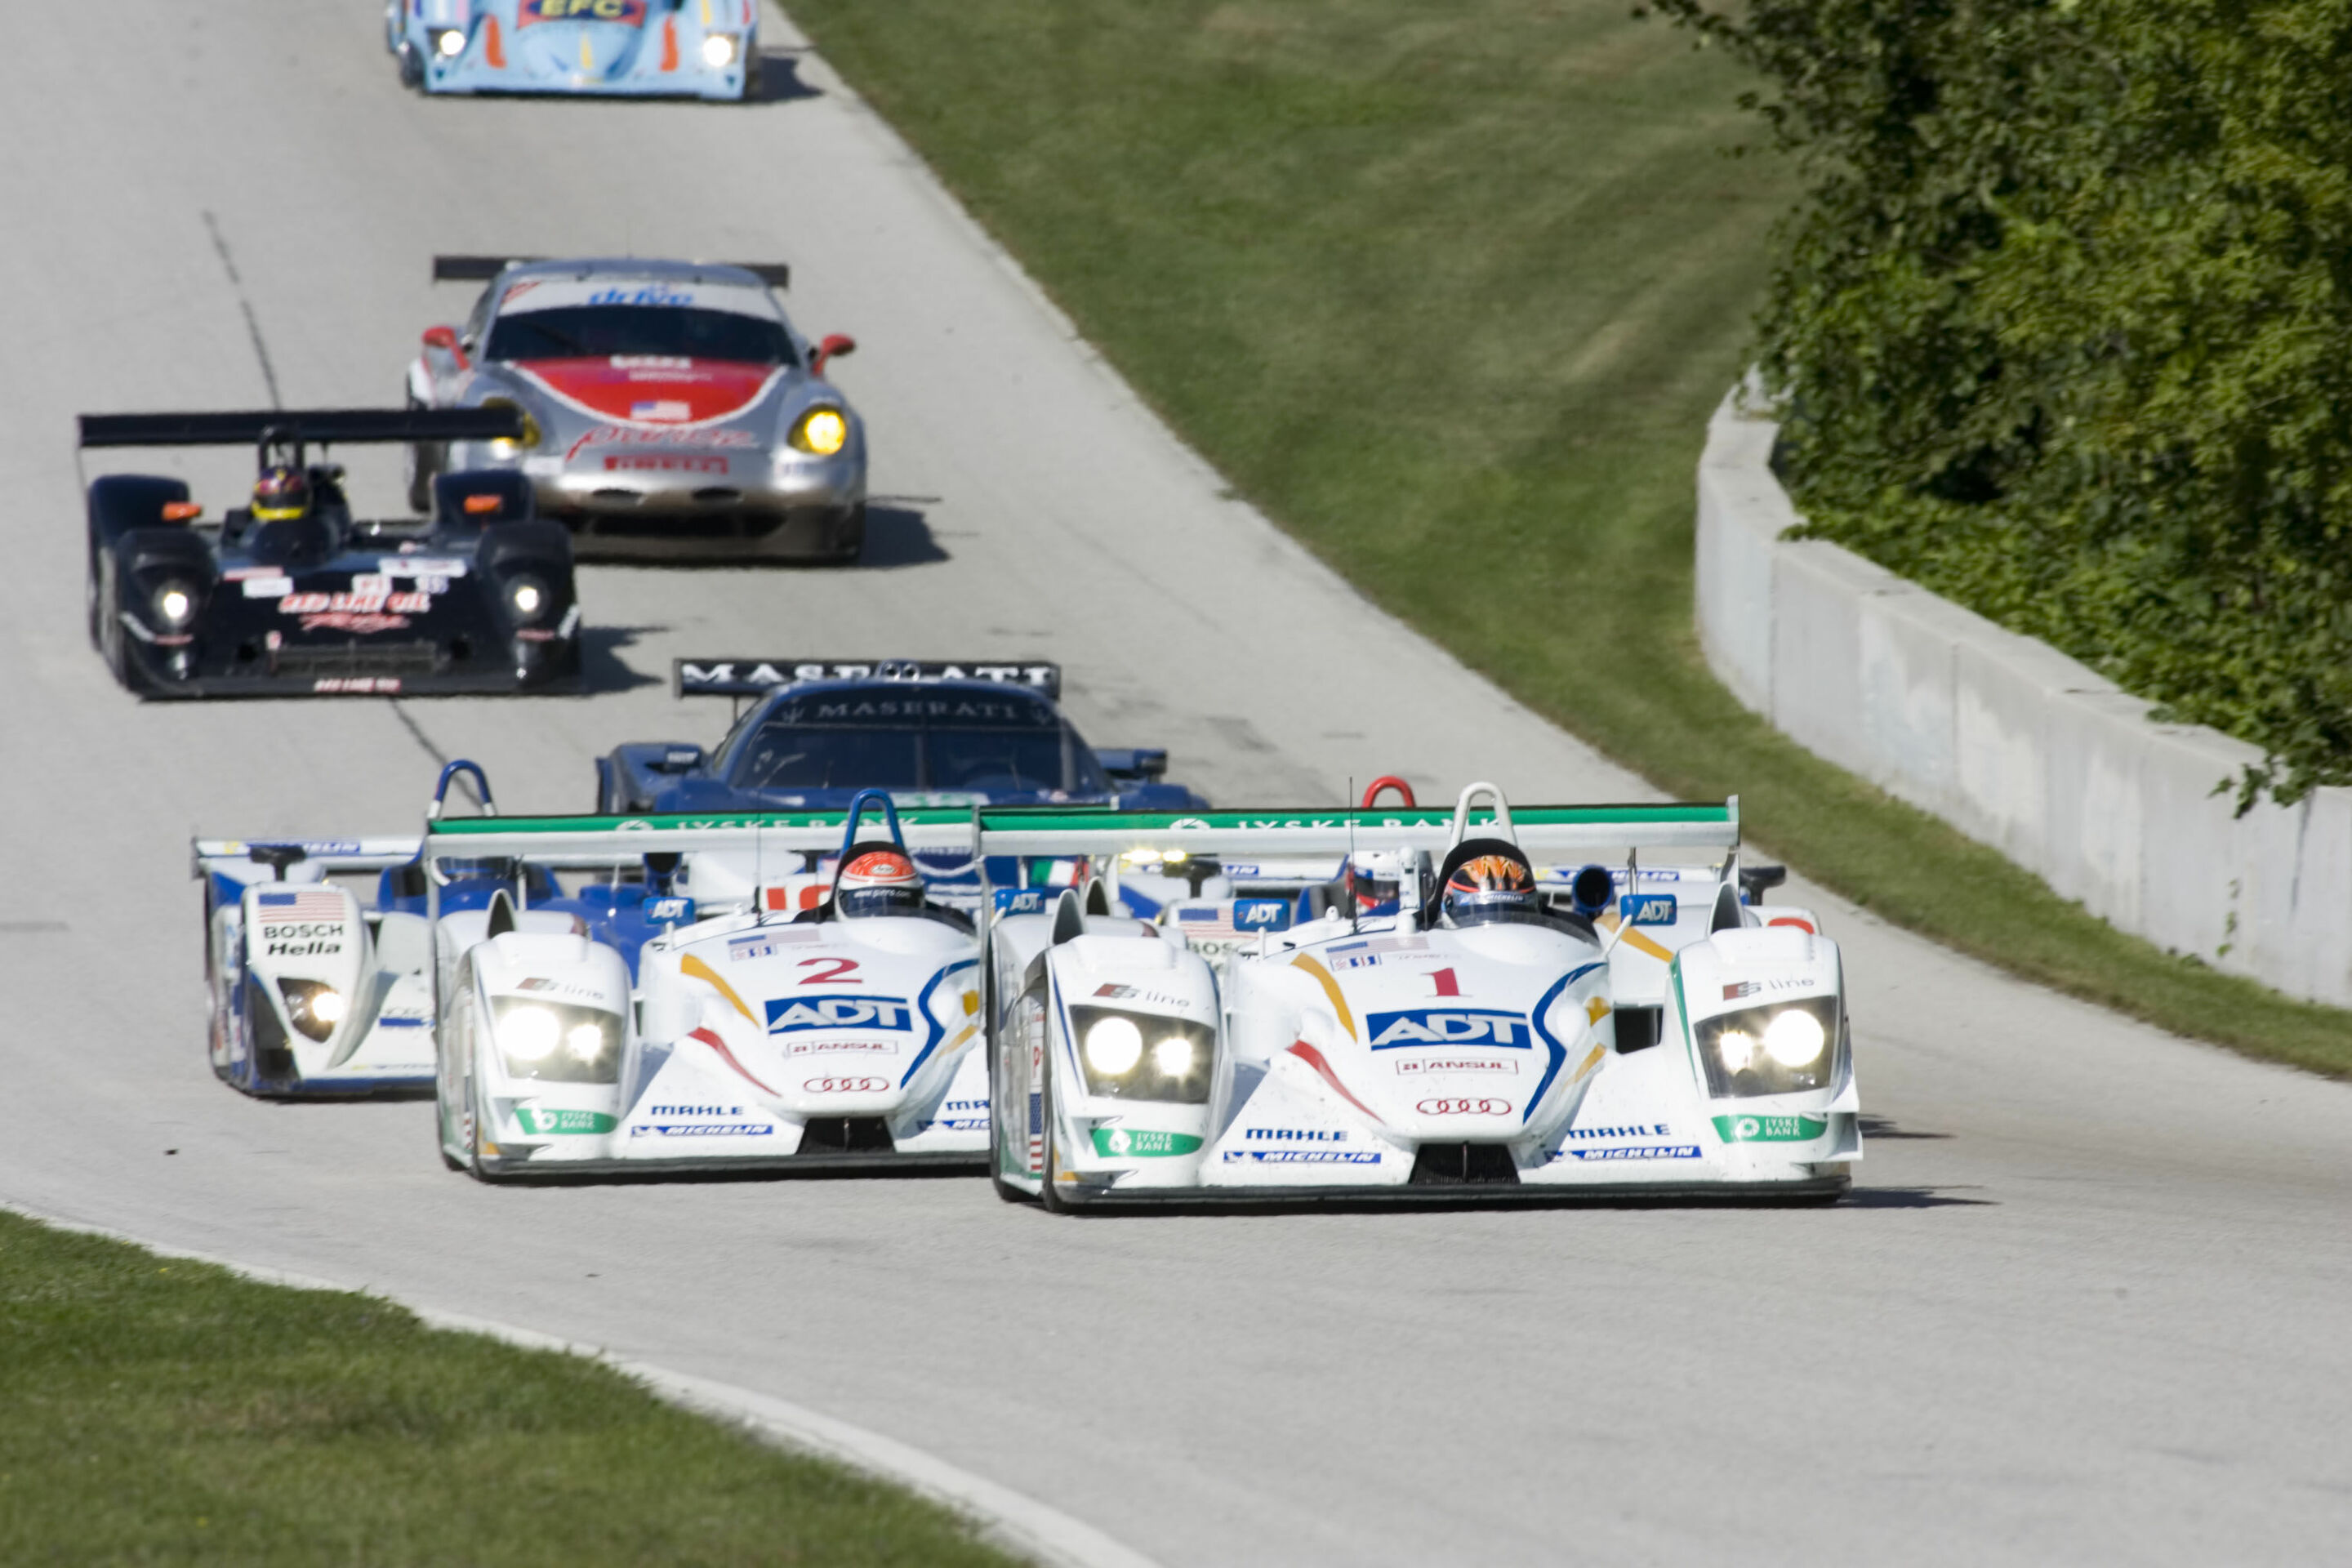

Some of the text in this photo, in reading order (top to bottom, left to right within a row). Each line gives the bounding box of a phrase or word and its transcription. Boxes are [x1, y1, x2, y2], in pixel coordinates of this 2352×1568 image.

[681, 662, 1051, 686] MASEATI
[817, 699, 1017, 717] MASERATI
[653, 899, 688, 918] ADT
[1009, 893, 1040, 911] ADT
[1245, 903, 1283, 924] ADT
[1636, 900, 1673, 923] ADT
[264, 923, 344, 938] BOSCH
[267, 941, 342, 956] Hella
[1189, 942, 1236, 956] BOS
[796, 957, 863, 986] 2
[1419, 967, 1473, 998] 1
[1768, 978, 1815, 990] line
[1145, 990, 1191, 1007] line
[768, 998, 908, 1031] ADT
[1370, 1013, 1529, 1046] ADT
[817, 1042, 890, 1051] ANSUL
[1428, 1061, 1509, 1070] ANSUL
[651, 1105, 745, 1116] MAHLE
[1765, 1116, 1800, 1127] JYSKE
[665, 1125, 768, 1137] MICHELIN
[1245, 1128, 1349, 1142] MAHLE
[1568, 1124, 1671, 1139] MAHLE
[1765, 1127, 1801, 1137] BANK
[1265, 1152, 1375, 1163] MICHELIN
[1584, 1147, 1695, 1160] MICHELIN
